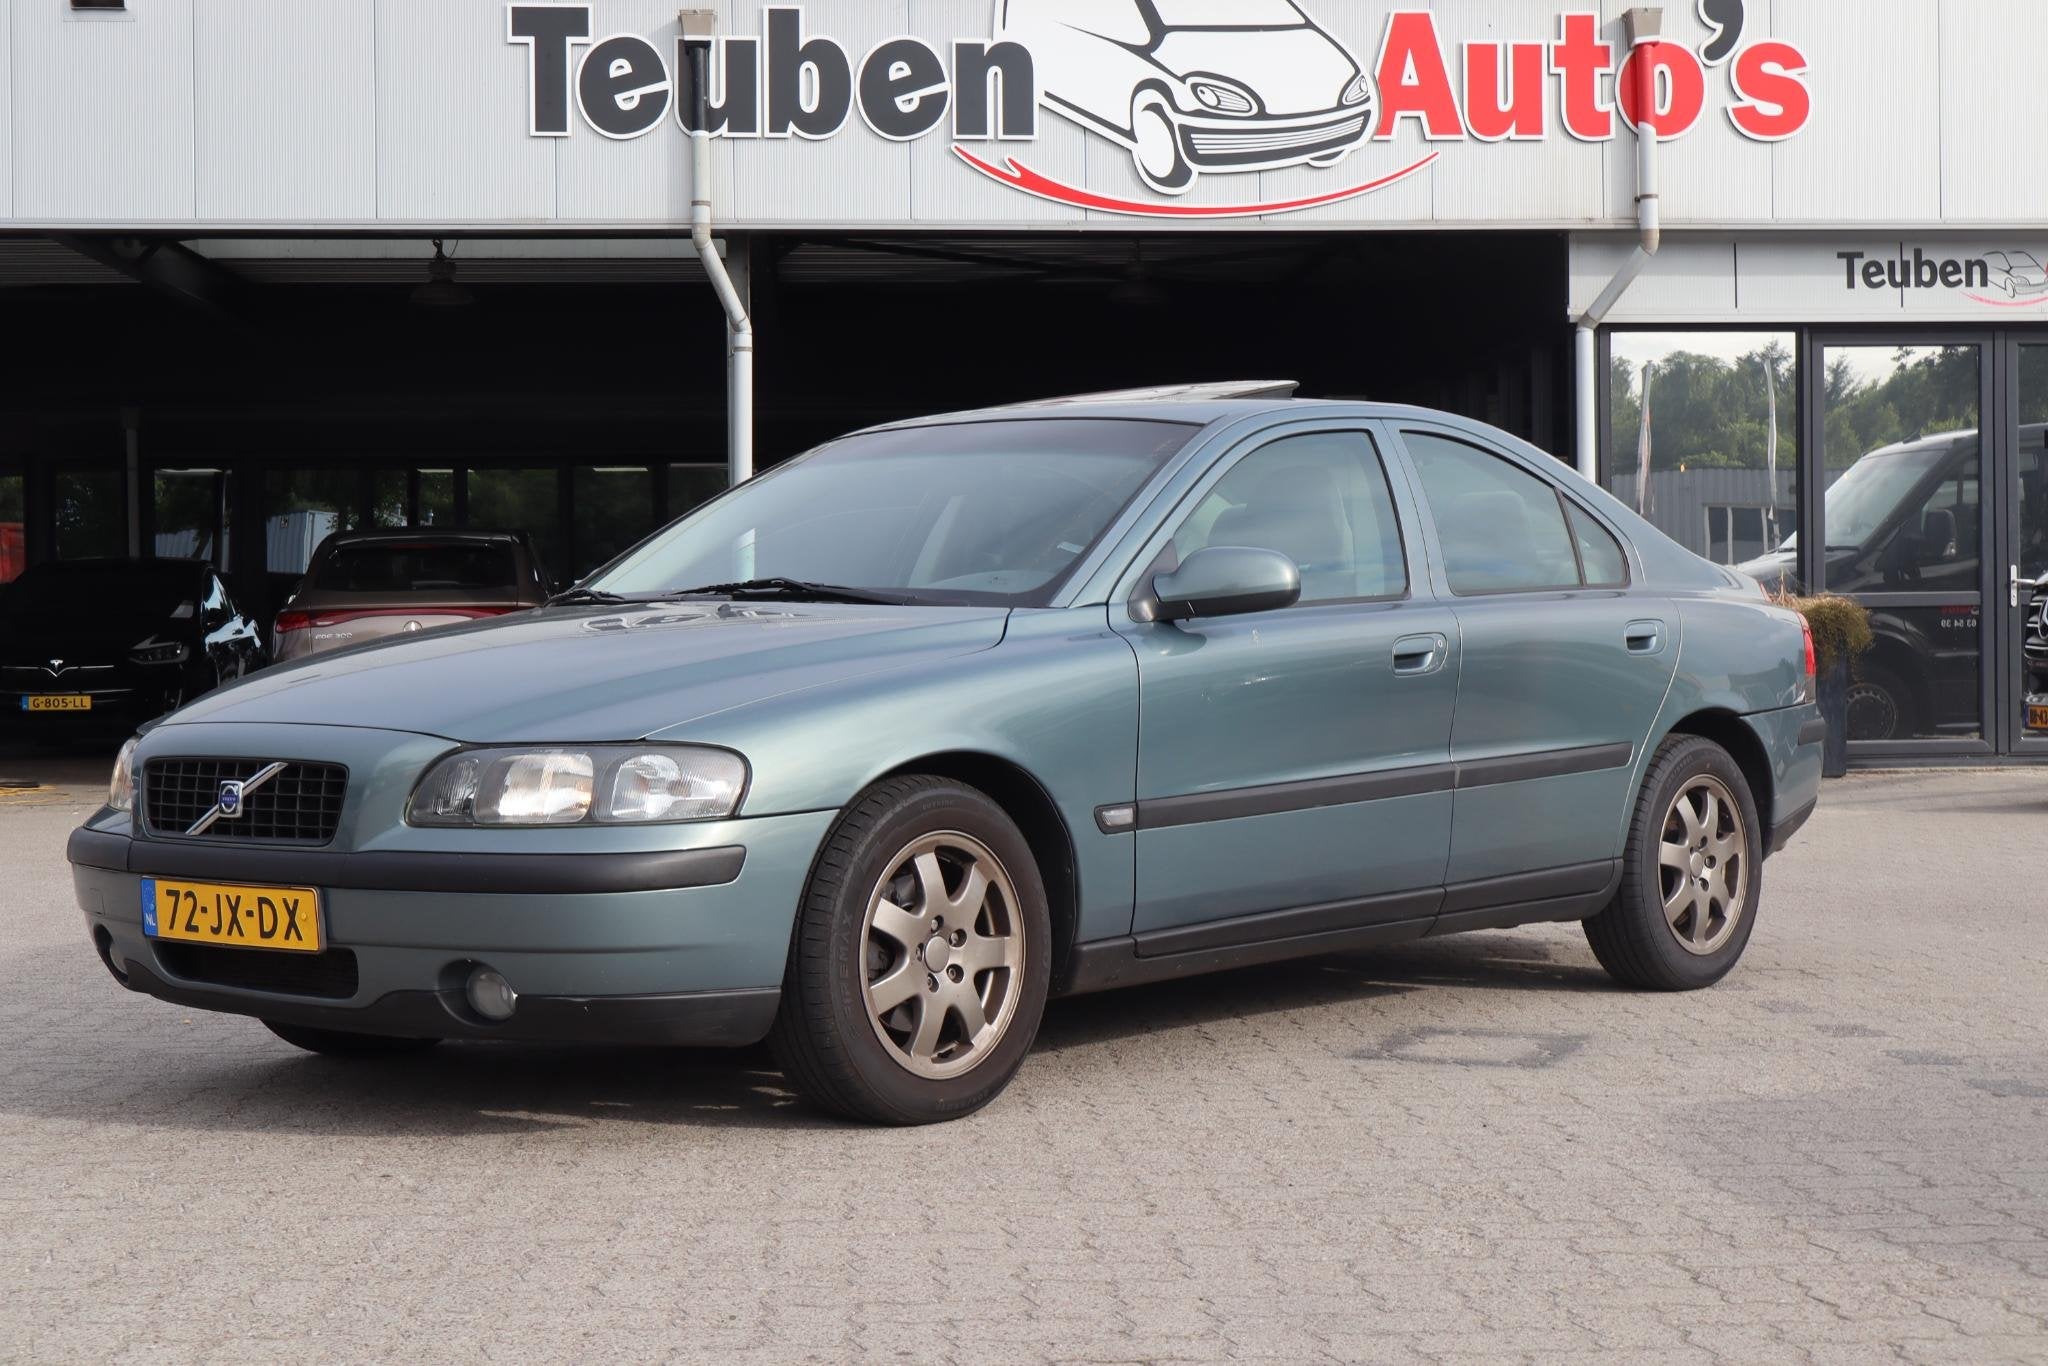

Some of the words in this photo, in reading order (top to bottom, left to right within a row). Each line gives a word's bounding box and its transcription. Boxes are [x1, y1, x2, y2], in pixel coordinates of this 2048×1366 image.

[509, 4, 1036, 138] Teuben
[1375, 0, 1811, 140] Auto's
[1836, 247, 1989, 289] Teuben
[32, 697, 88, 709] G-805-LL
[144, 913, 156, 926] NL
[165, 889, 304, 941] 72-JX-DX
